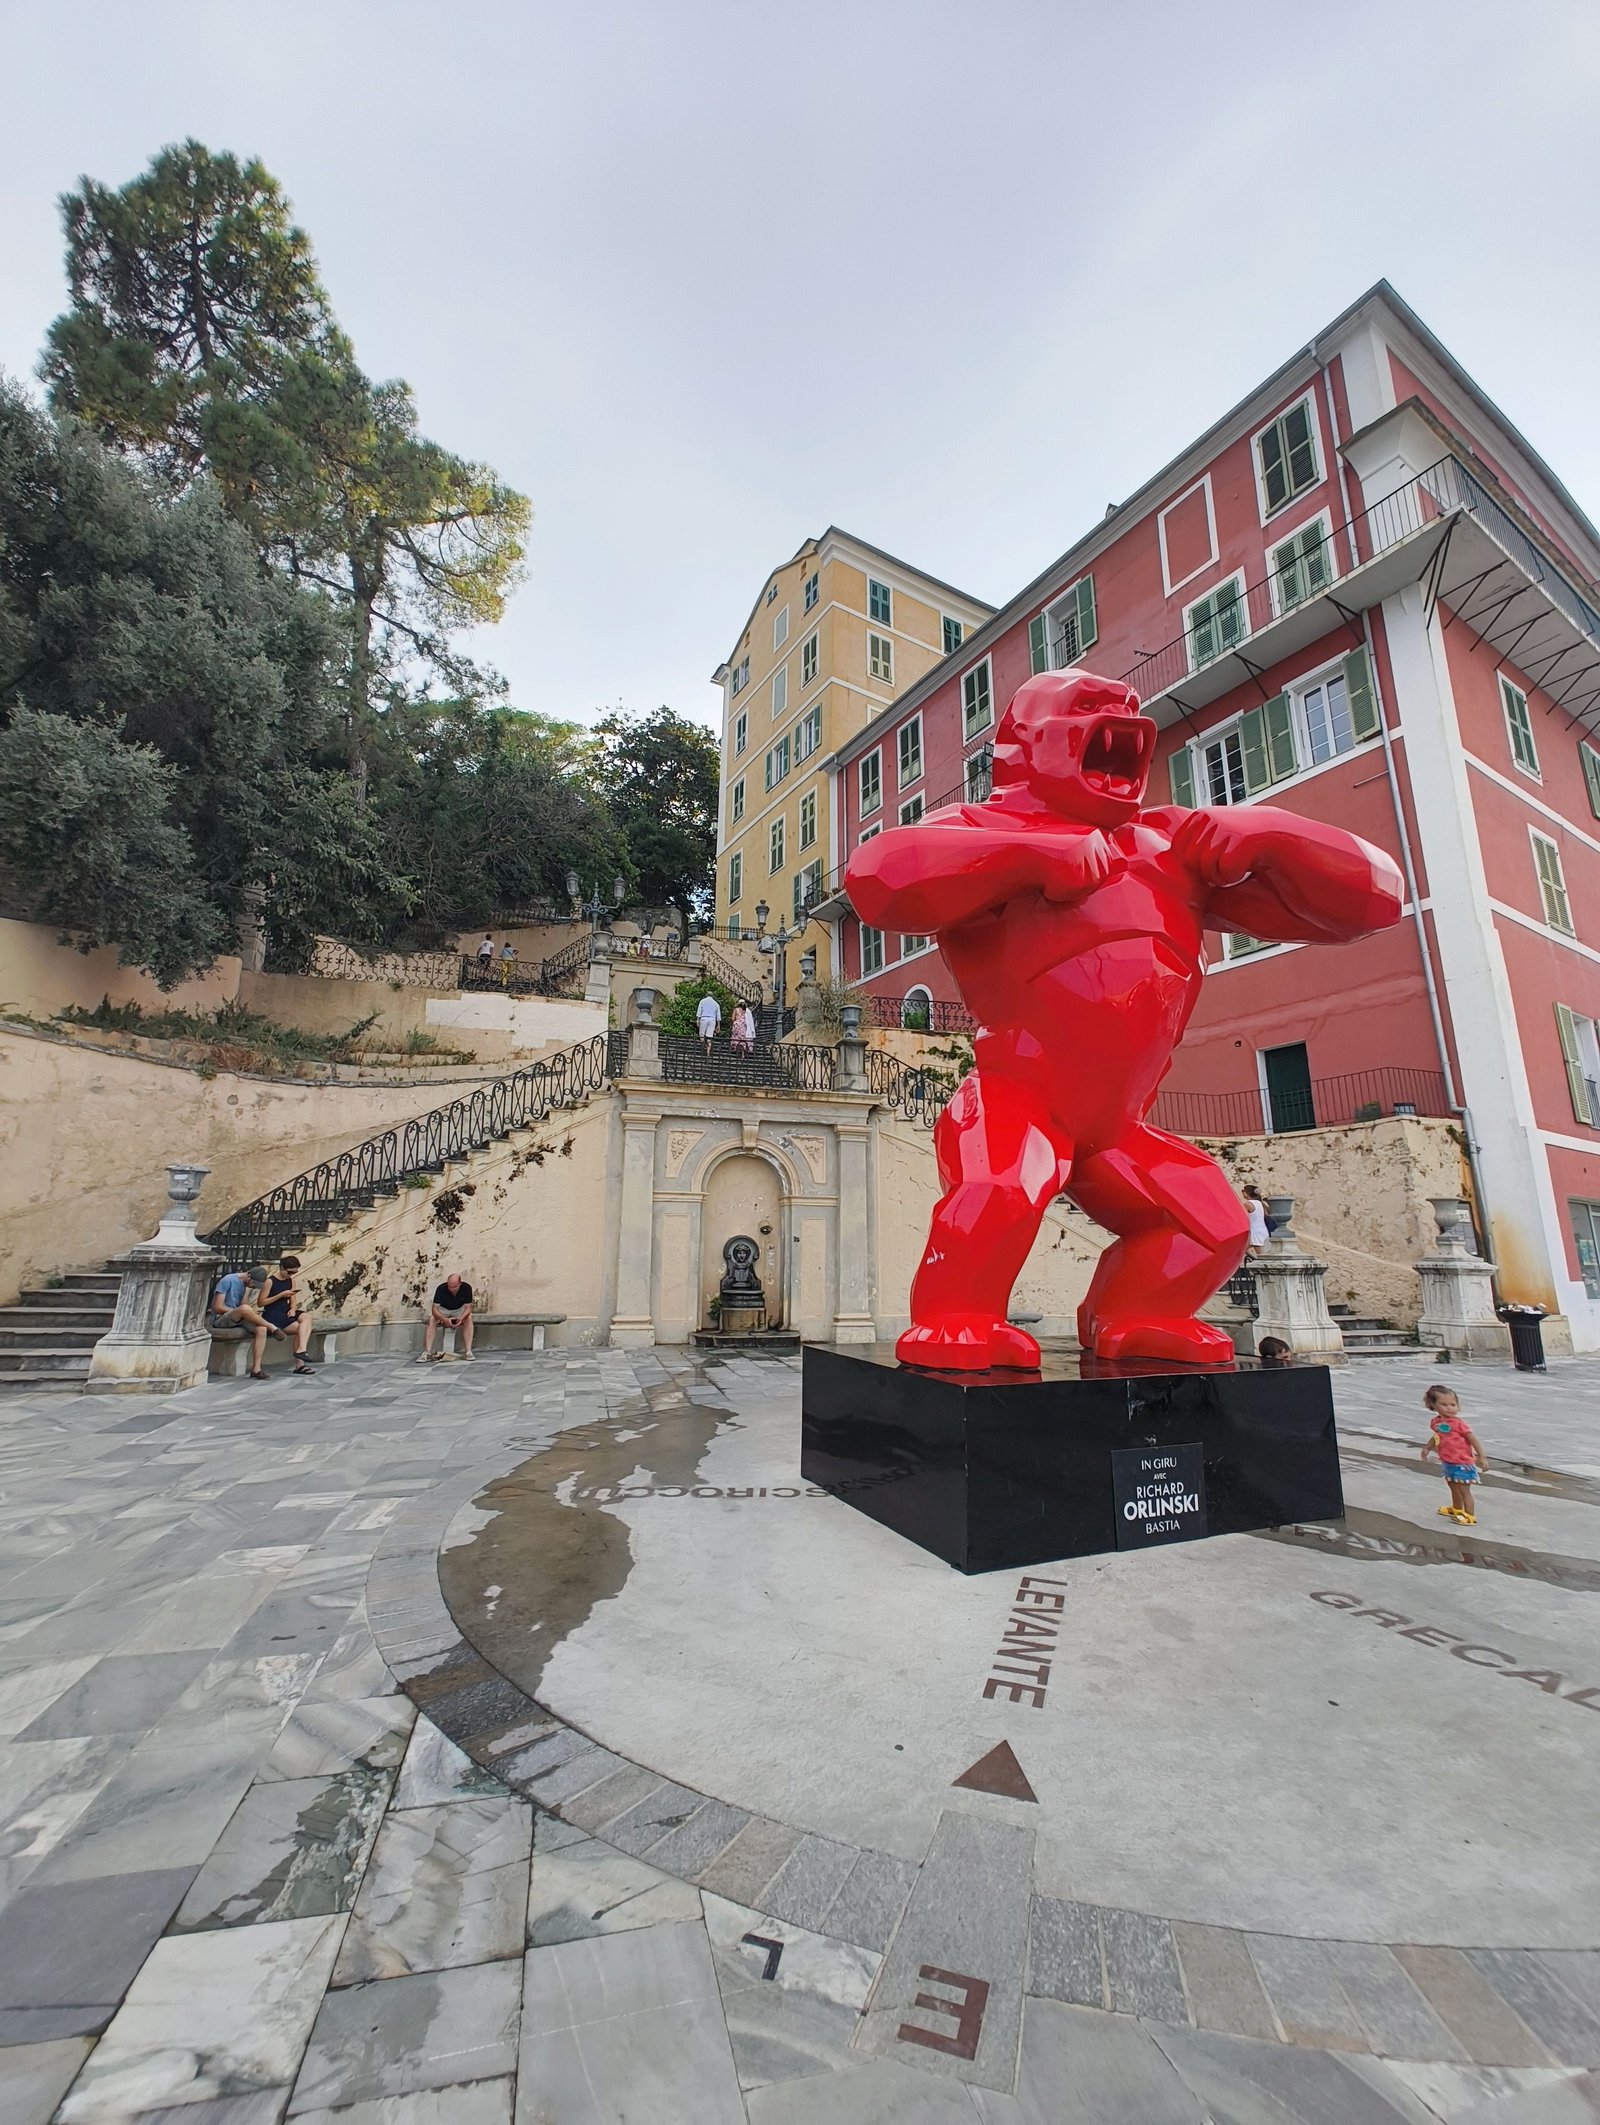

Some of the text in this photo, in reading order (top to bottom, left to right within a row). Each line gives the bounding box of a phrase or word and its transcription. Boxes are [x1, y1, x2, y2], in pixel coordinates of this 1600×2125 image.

[1141, 1457, 1177, 1470] IN GIRU
[1136, 1482, 1184, 1499] RICHARD
[1123, 1493, 1200, 1521] ORLINSKI
[1145, 1520, 1181, 1534] BASTIA
[982, 1576, 1068, 1708] LEVANTE
[1309, 1591, 1600, 1712] GRECAL
[898, 1964, 990, 2061] E
